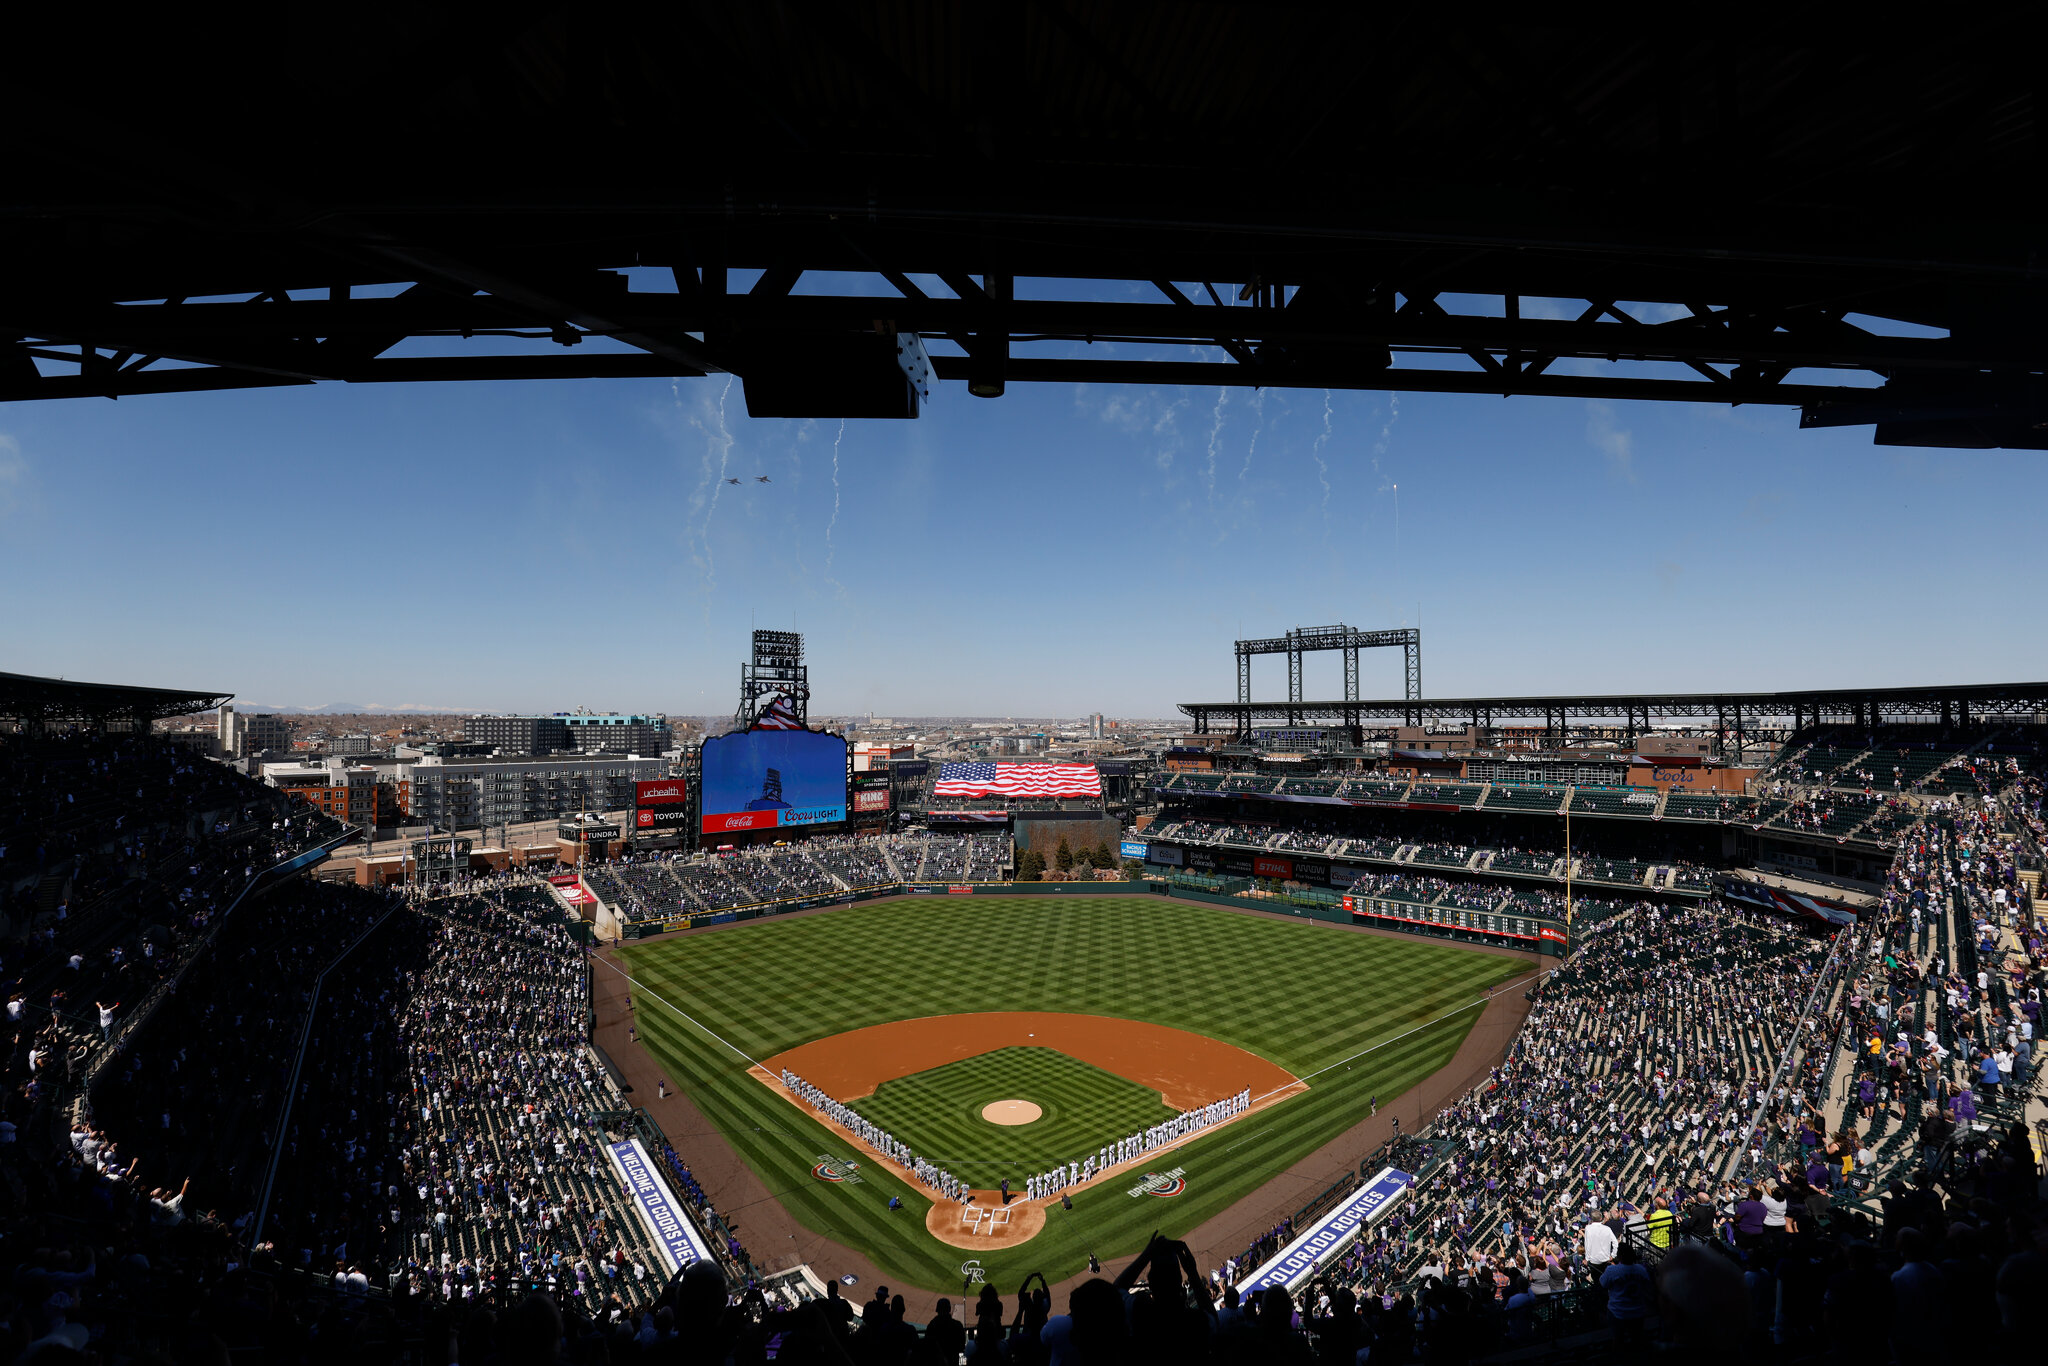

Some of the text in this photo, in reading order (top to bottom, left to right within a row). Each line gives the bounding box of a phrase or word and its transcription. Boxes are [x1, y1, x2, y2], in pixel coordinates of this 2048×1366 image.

[1518, 754, 1541, 763] Silver
[1652, 767, 1694, 784] Coors
[643, 786, 679, 798] uchealth
[860, 791, 884, 802] KING
[654, 812, 685, 821] TOYOTA
[784, 809, 838, 822] Coors LIGHT
[588, 831, 617, 839] TUNDRA
[1190, 851, 1203, 859] Bank
[1190, 858, 1216, 868] Colorado
[1259, 863, 1288, 873] STIHL
[1332, 872, 1353, 882] Coors
[1127, 1166, 1186, 1198] OPENING DAY
[621, 1151, 697, 1265] WELCOME TO COORS FIEL
[1335, 1190, 1385, 1232] ROCKIES
